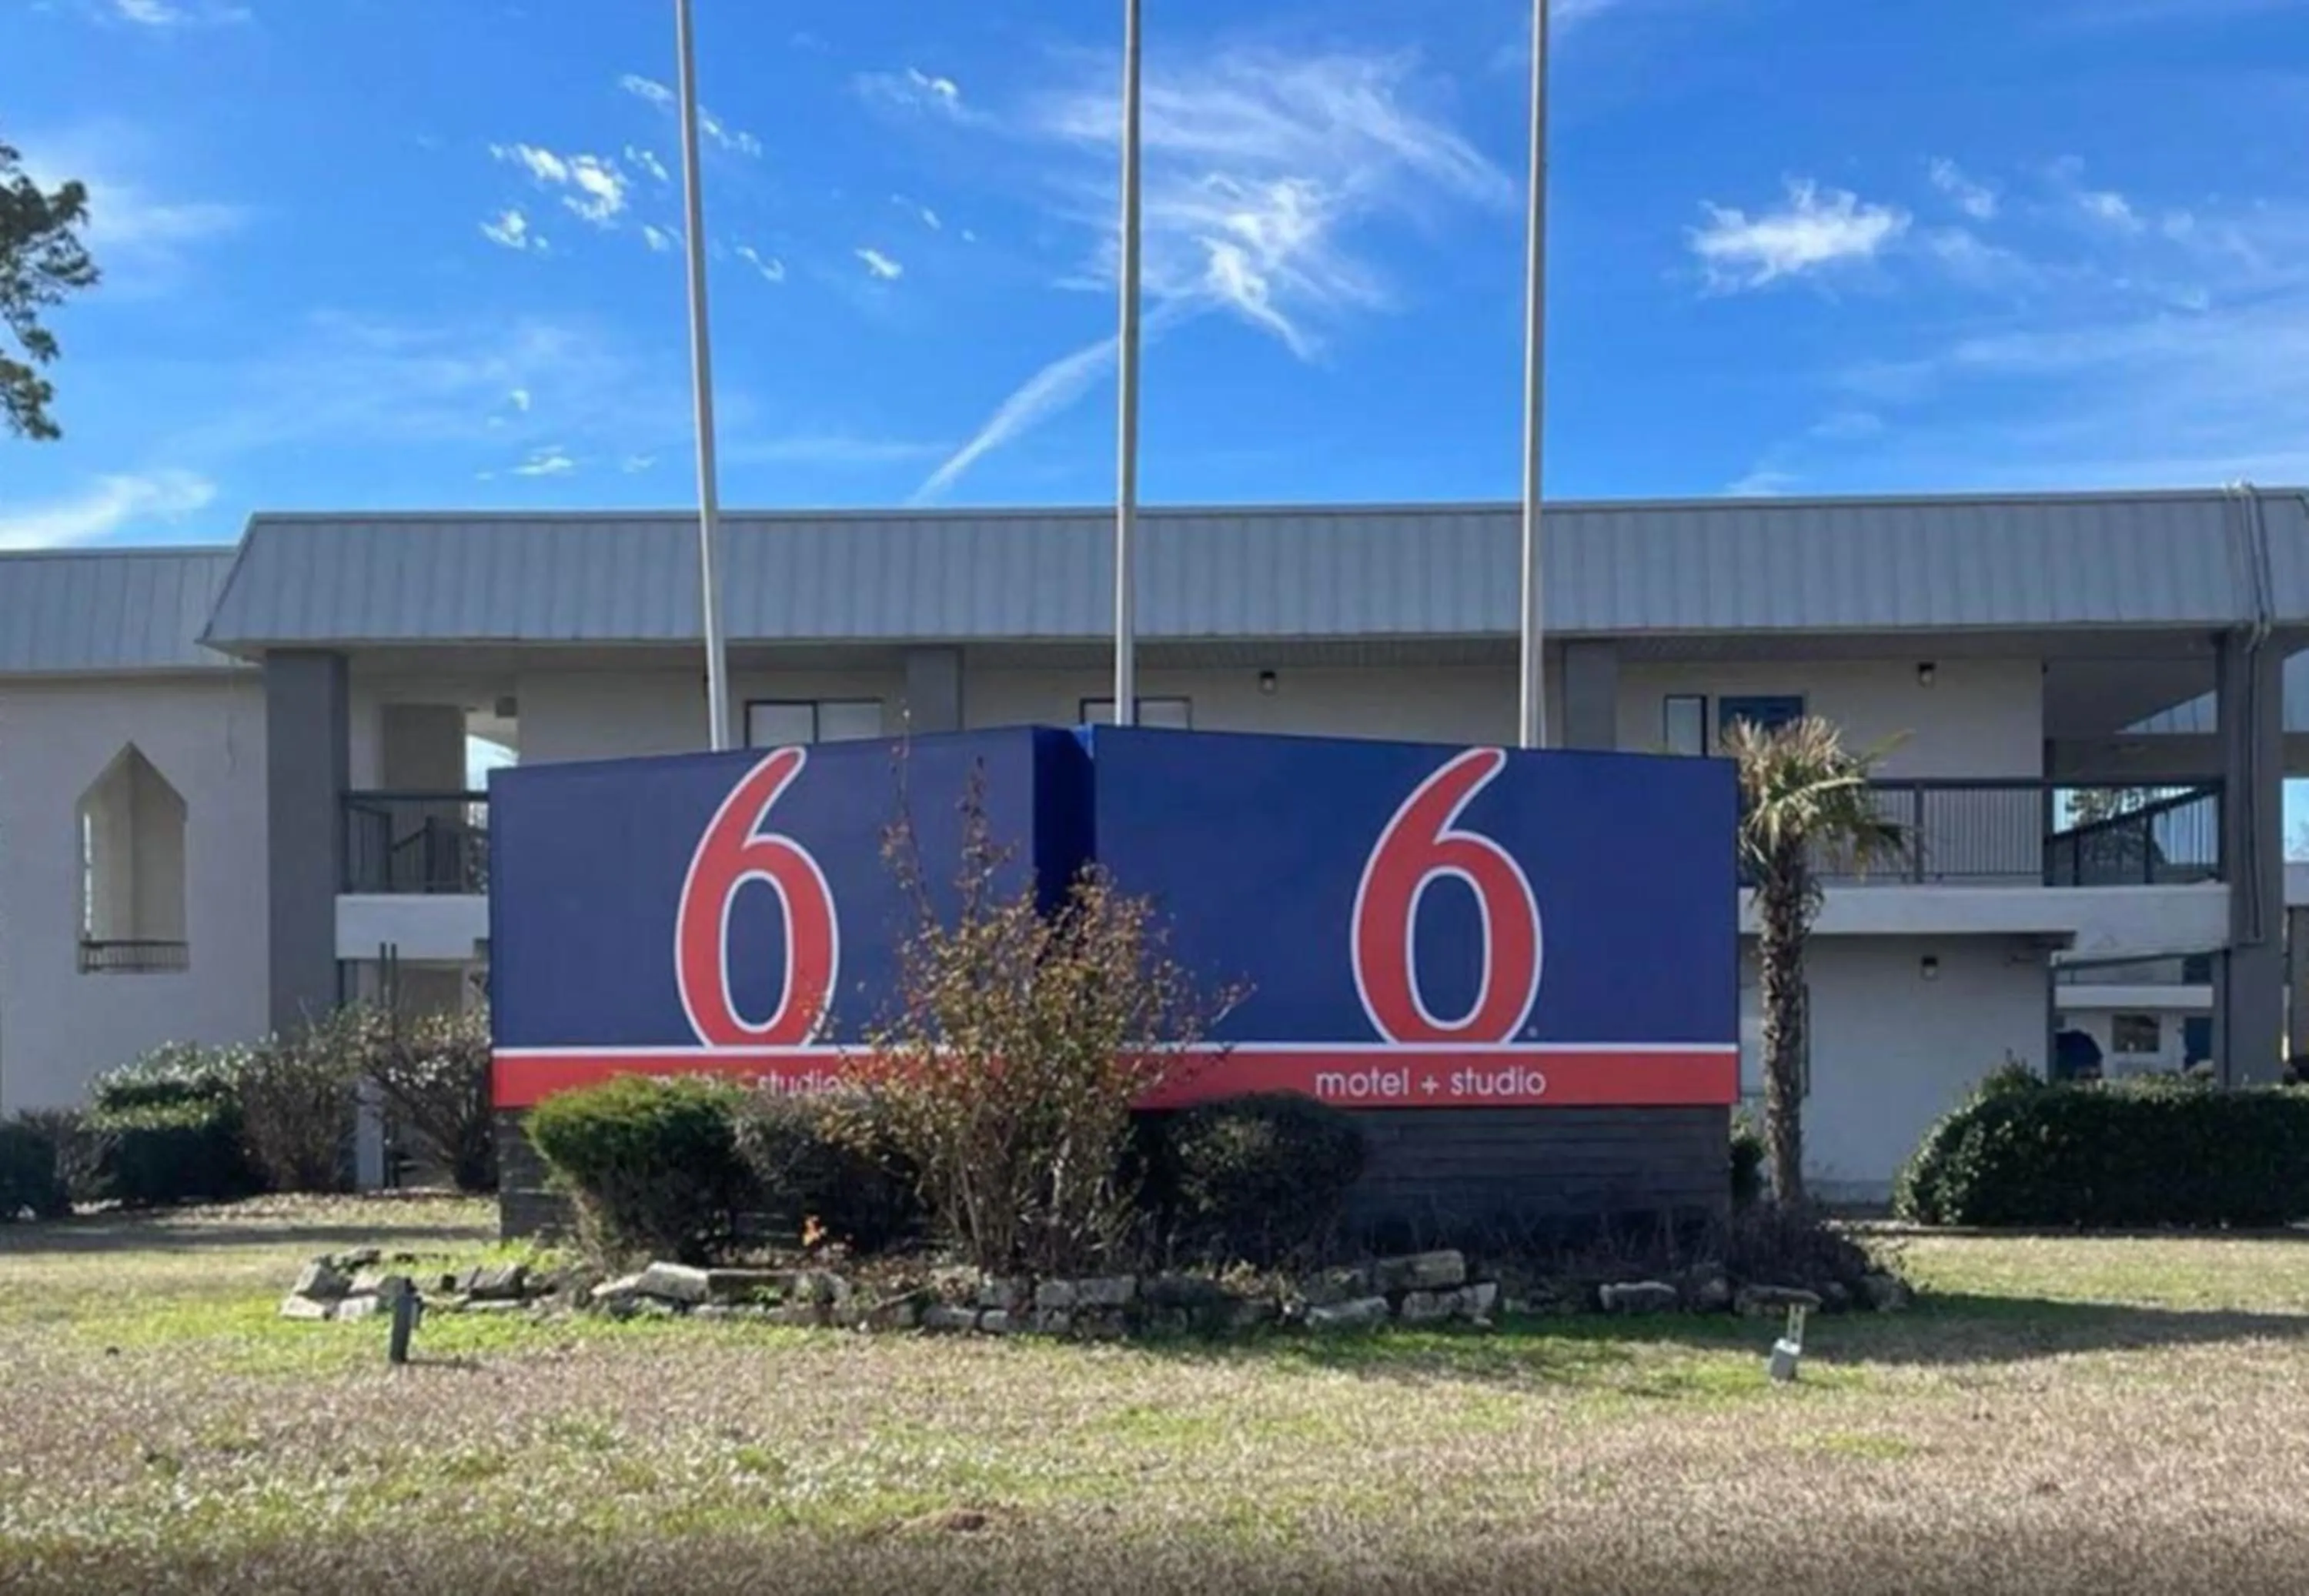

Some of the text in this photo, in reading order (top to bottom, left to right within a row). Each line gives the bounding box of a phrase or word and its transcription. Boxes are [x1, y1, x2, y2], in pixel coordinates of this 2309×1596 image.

[674, 746, 840, 1047] 6
[1351, 746, 1543, 1045] 6
[1315, 1067, 1409, 1097] motel
[1450, 1067, 1548, 1097] studio
